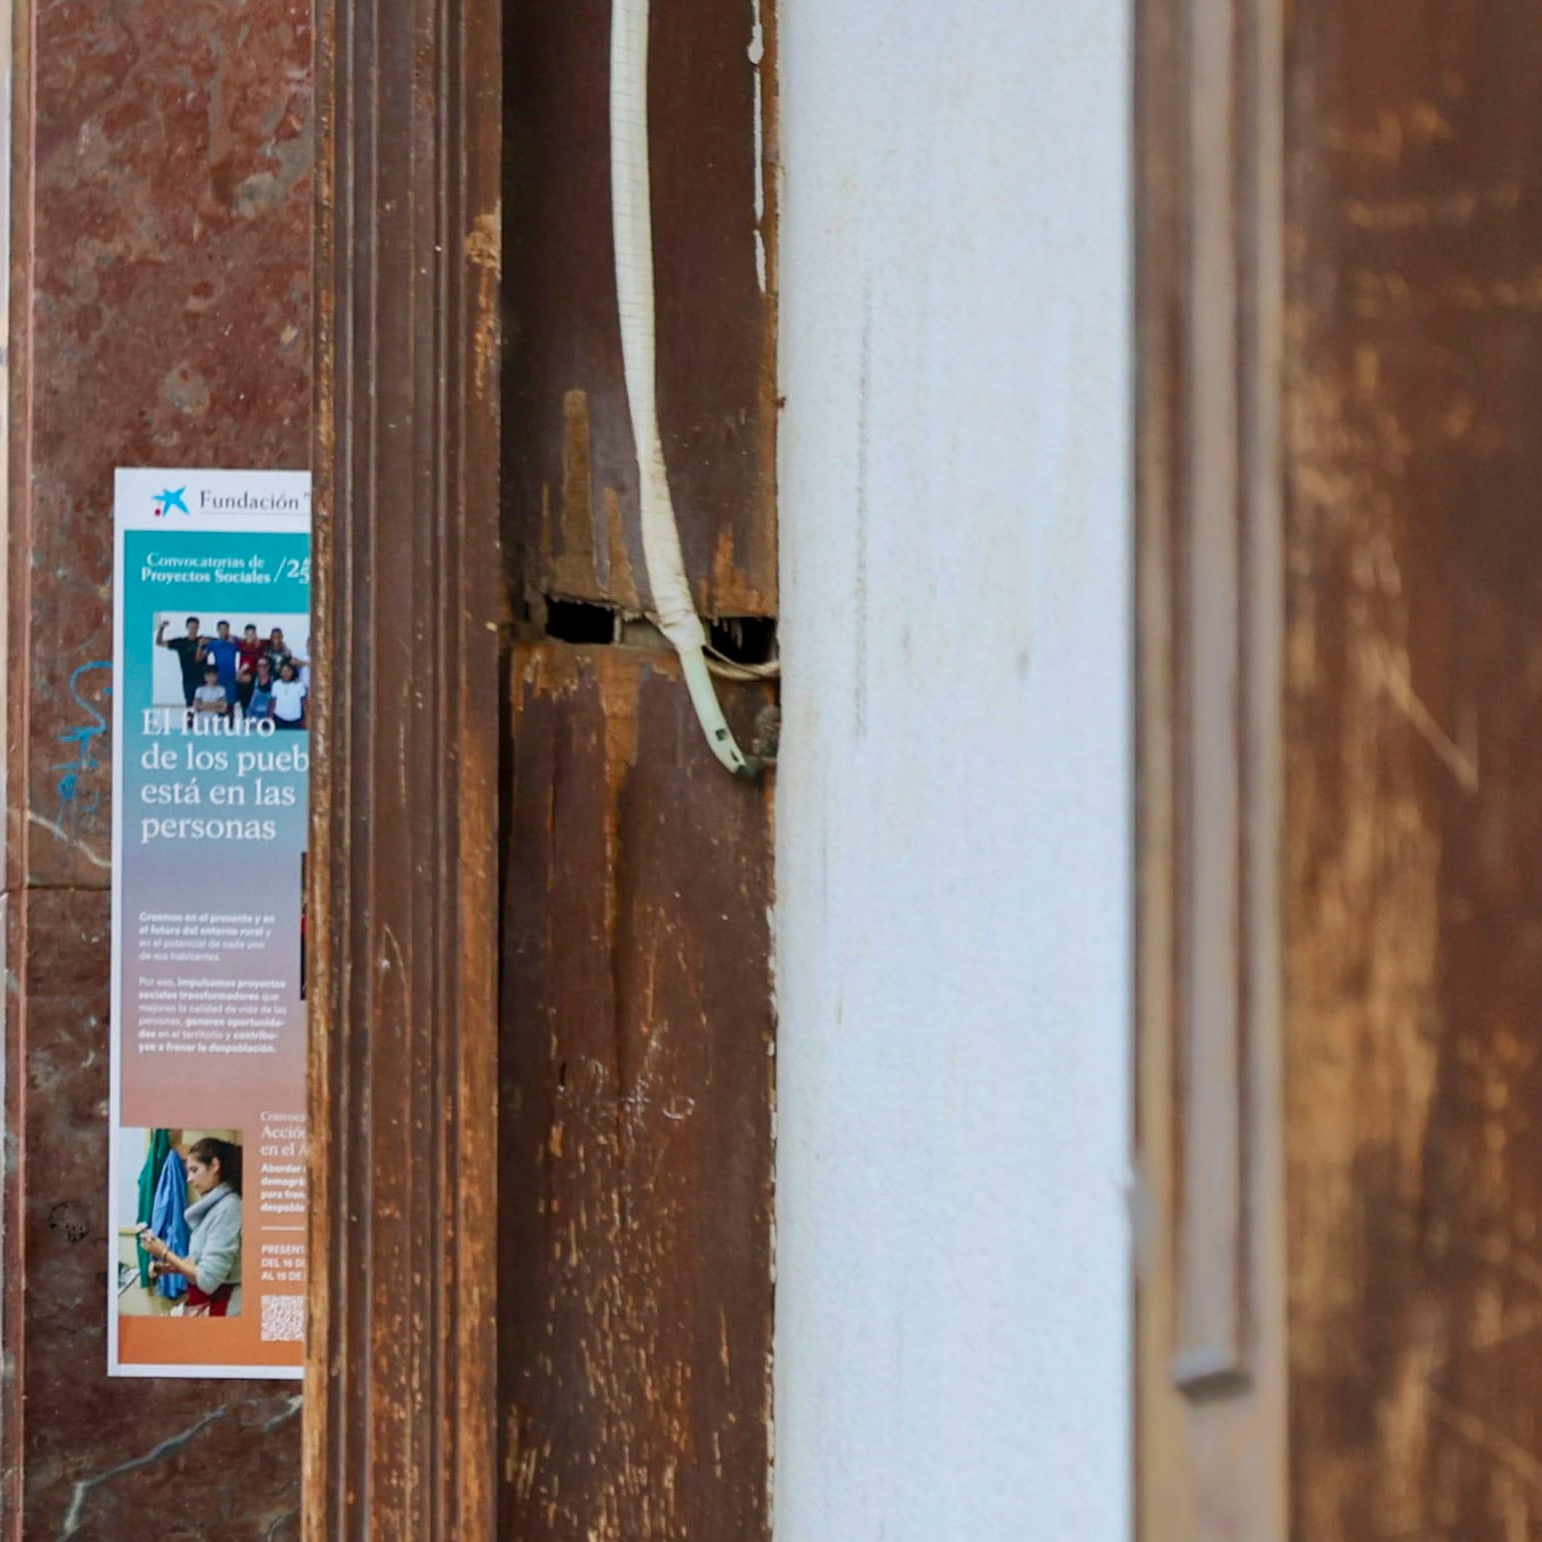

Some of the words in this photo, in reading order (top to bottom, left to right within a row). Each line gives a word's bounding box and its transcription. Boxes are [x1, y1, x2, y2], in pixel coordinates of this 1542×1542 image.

[200, 490, 299, 510] Fundación
[147, 552, 245, 569] Convocatorias
[248, 554, 265, 569] de
[141, 568, 210, 584] Proyectos
[215, 569, 271, 584] Sociales
[141, 709, 170, 736] El
[180, 708, 275, 737] futuro
[141, 742, 178, 770] de
[186, 742, 228, 771] los
[237, 744, 309, 776] pueb
[141, 778, 201, 805] está
[209, 783, 245, 805] en
[255, 778, 296, 806] las
[141, 817, 276, 844] personas
[139, 912, 183, 923] Creemos
[185, 914, 197, 922] en
[210, 913, 252, 925] presente
[183, 926, 198, 936] del
[164, 939, 206, 950] potencial
[177, 977, 235, 988] impulsamos
[237, 980, 285, 990] proyectos
[138, 991, 177, 1001] sociales
[179, 992, 259, 1001] transformadores
[189, 1004, 223, 1014] calidad
[261, 1143, 279, 1157] en
[281, 1142, 295, 1157] el
[261, 1163, 300, 1174] Abordar
[261, 1190, 282, 1200] para
[261, 1258, 280, 1268] DEL
[261, 1271, 276, 1281] AL
